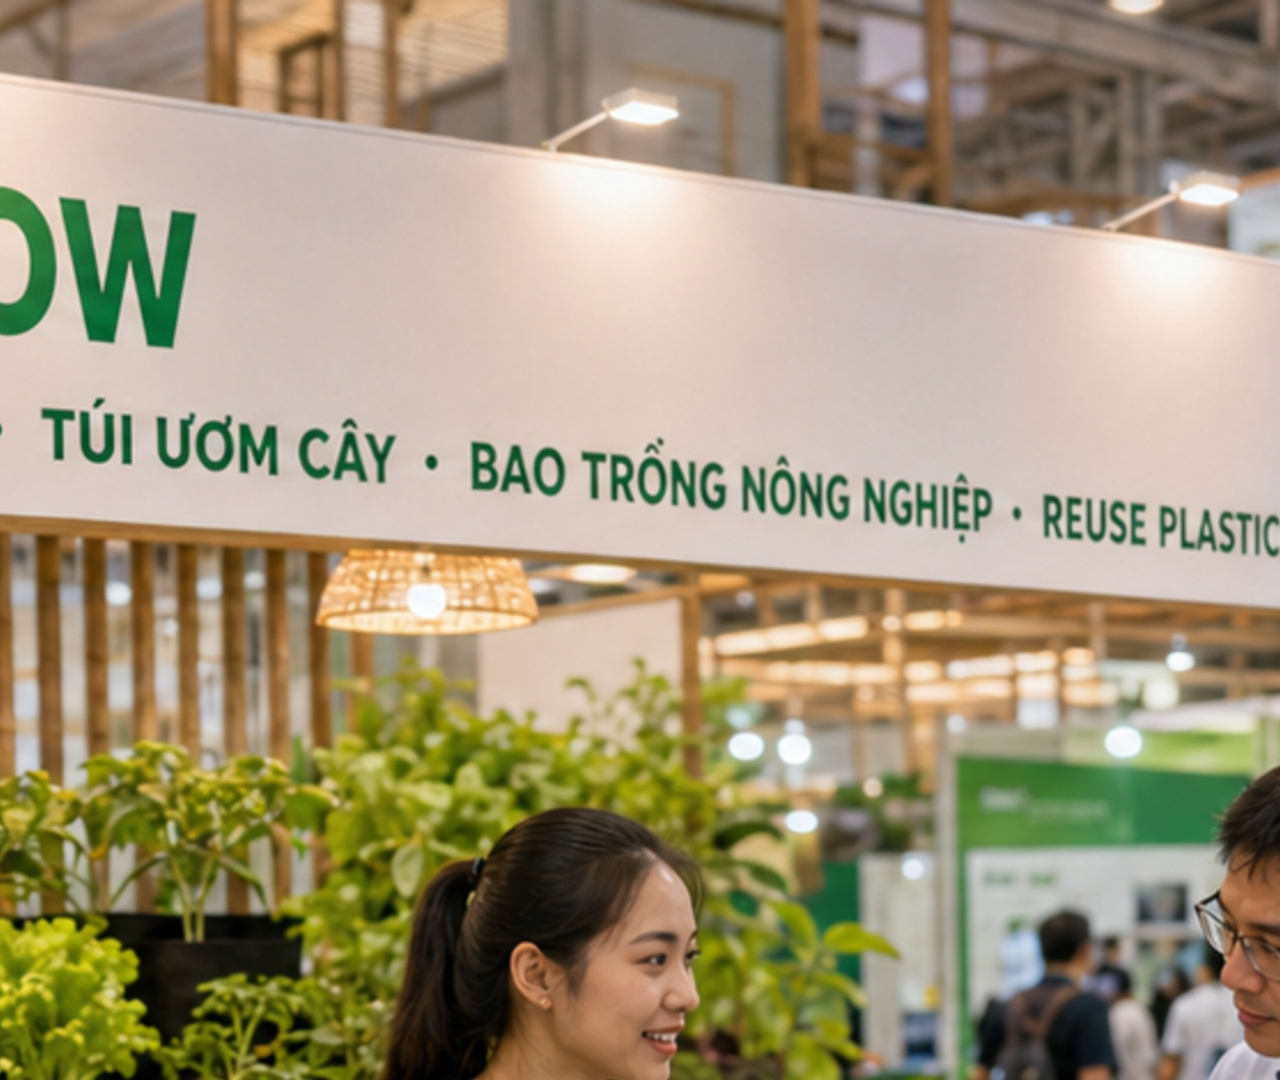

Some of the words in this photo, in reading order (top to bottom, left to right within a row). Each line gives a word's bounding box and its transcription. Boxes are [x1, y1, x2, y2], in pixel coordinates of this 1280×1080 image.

[41, 397, 132, 465] TÚI
[157, 412, 278, 476] ƯƠM
[298, 418, 397, 483] CÂY
[471, 441, 566, 497] BAO
[741, 455, 850, 521] NÔNG
[864, 473, 992, 544] NGHIỆP
[1043, 494, 1147, 546] REUSE
